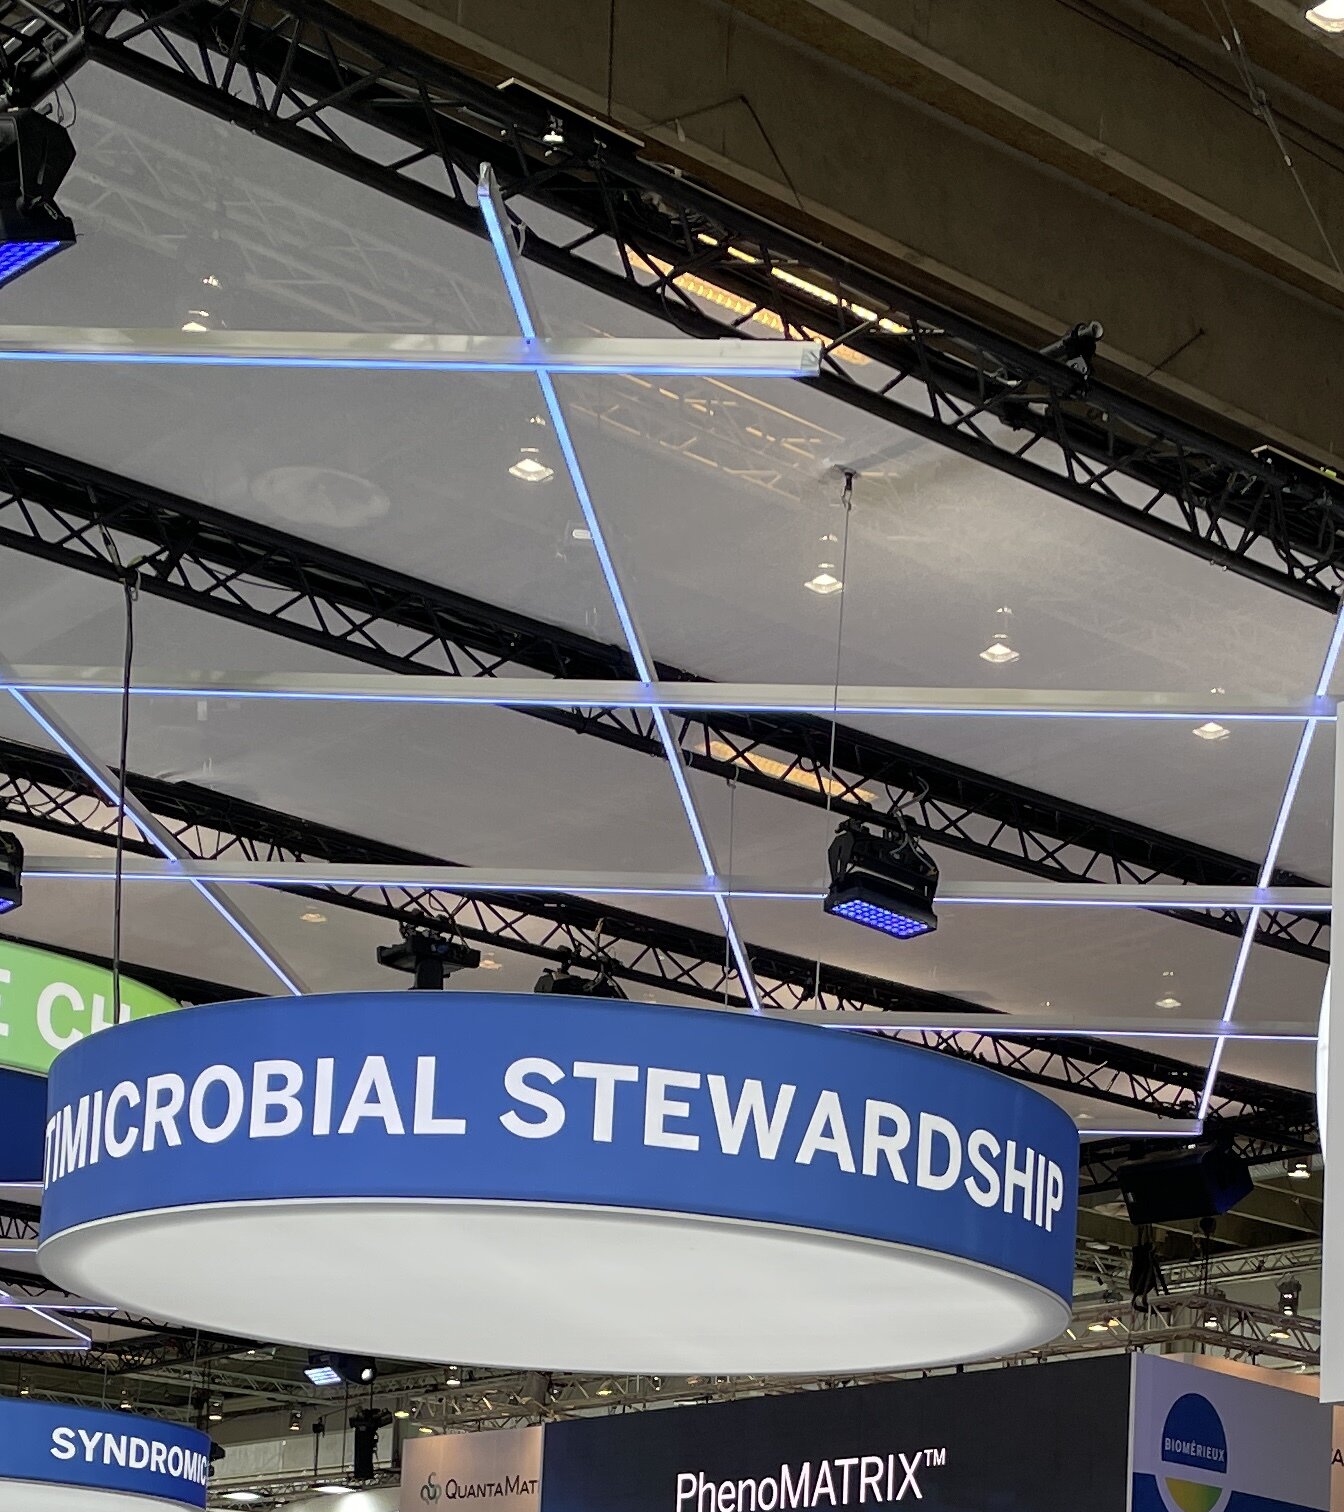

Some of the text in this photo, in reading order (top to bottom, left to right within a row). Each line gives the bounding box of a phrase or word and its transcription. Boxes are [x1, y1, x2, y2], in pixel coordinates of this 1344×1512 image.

[37, 982, 151, 1050] CH
[499, 1057, 1063, 1232] STEWARDSHIP
[50, 1427, 207, 1486] SYNDROMIC
[1164, 1437, 1225, 1462] BIOMÉRIEUX
